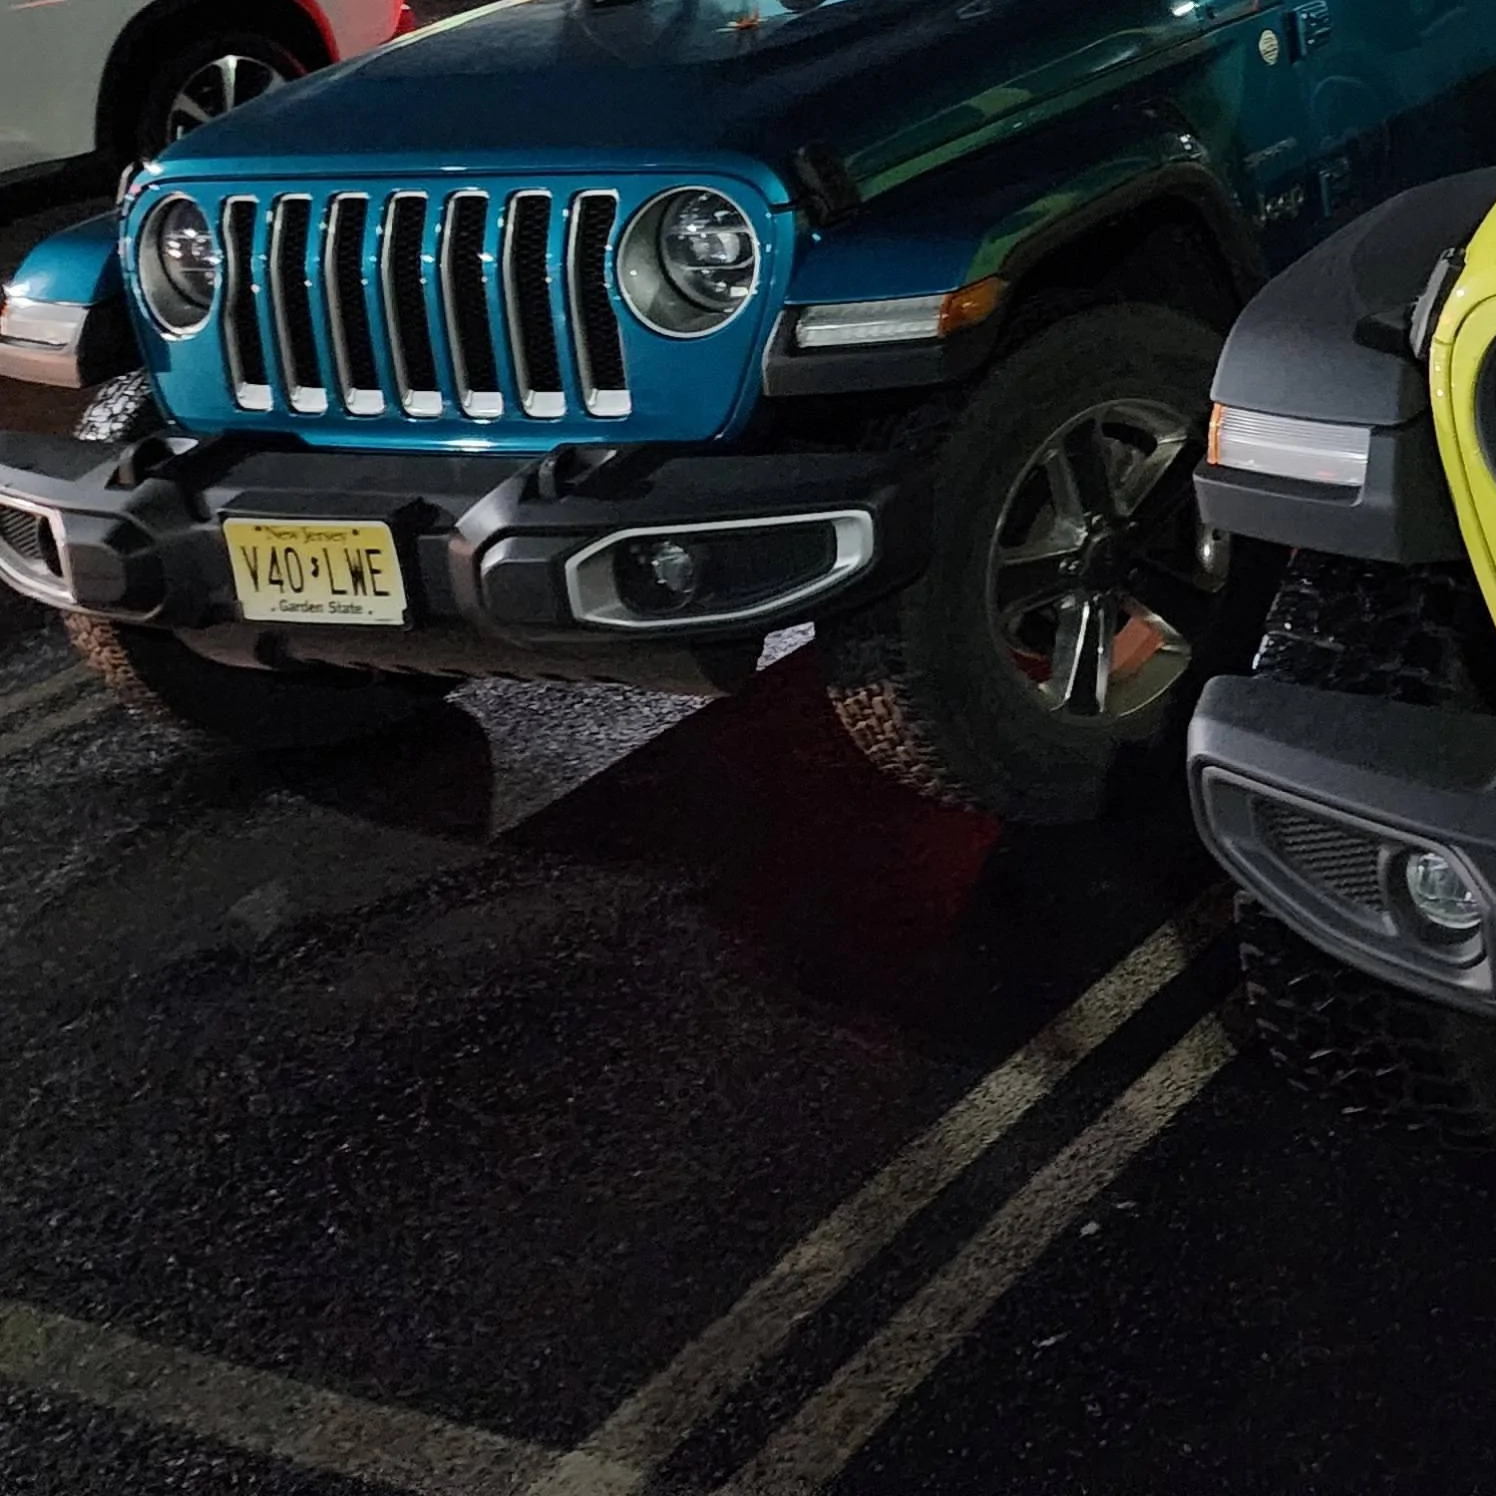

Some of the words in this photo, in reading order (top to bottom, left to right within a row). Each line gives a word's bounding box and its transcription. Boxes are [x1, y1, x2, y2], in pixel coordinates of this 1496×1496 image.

[265, 525, 299, 541] New
[301, 526, 349, 544] Jersey
[241, 546, 305, 594] V40
[322, 546, 390, 597] LWE
[279, 599, 324, 613] Garden
[328, 600, 364, 615] State
